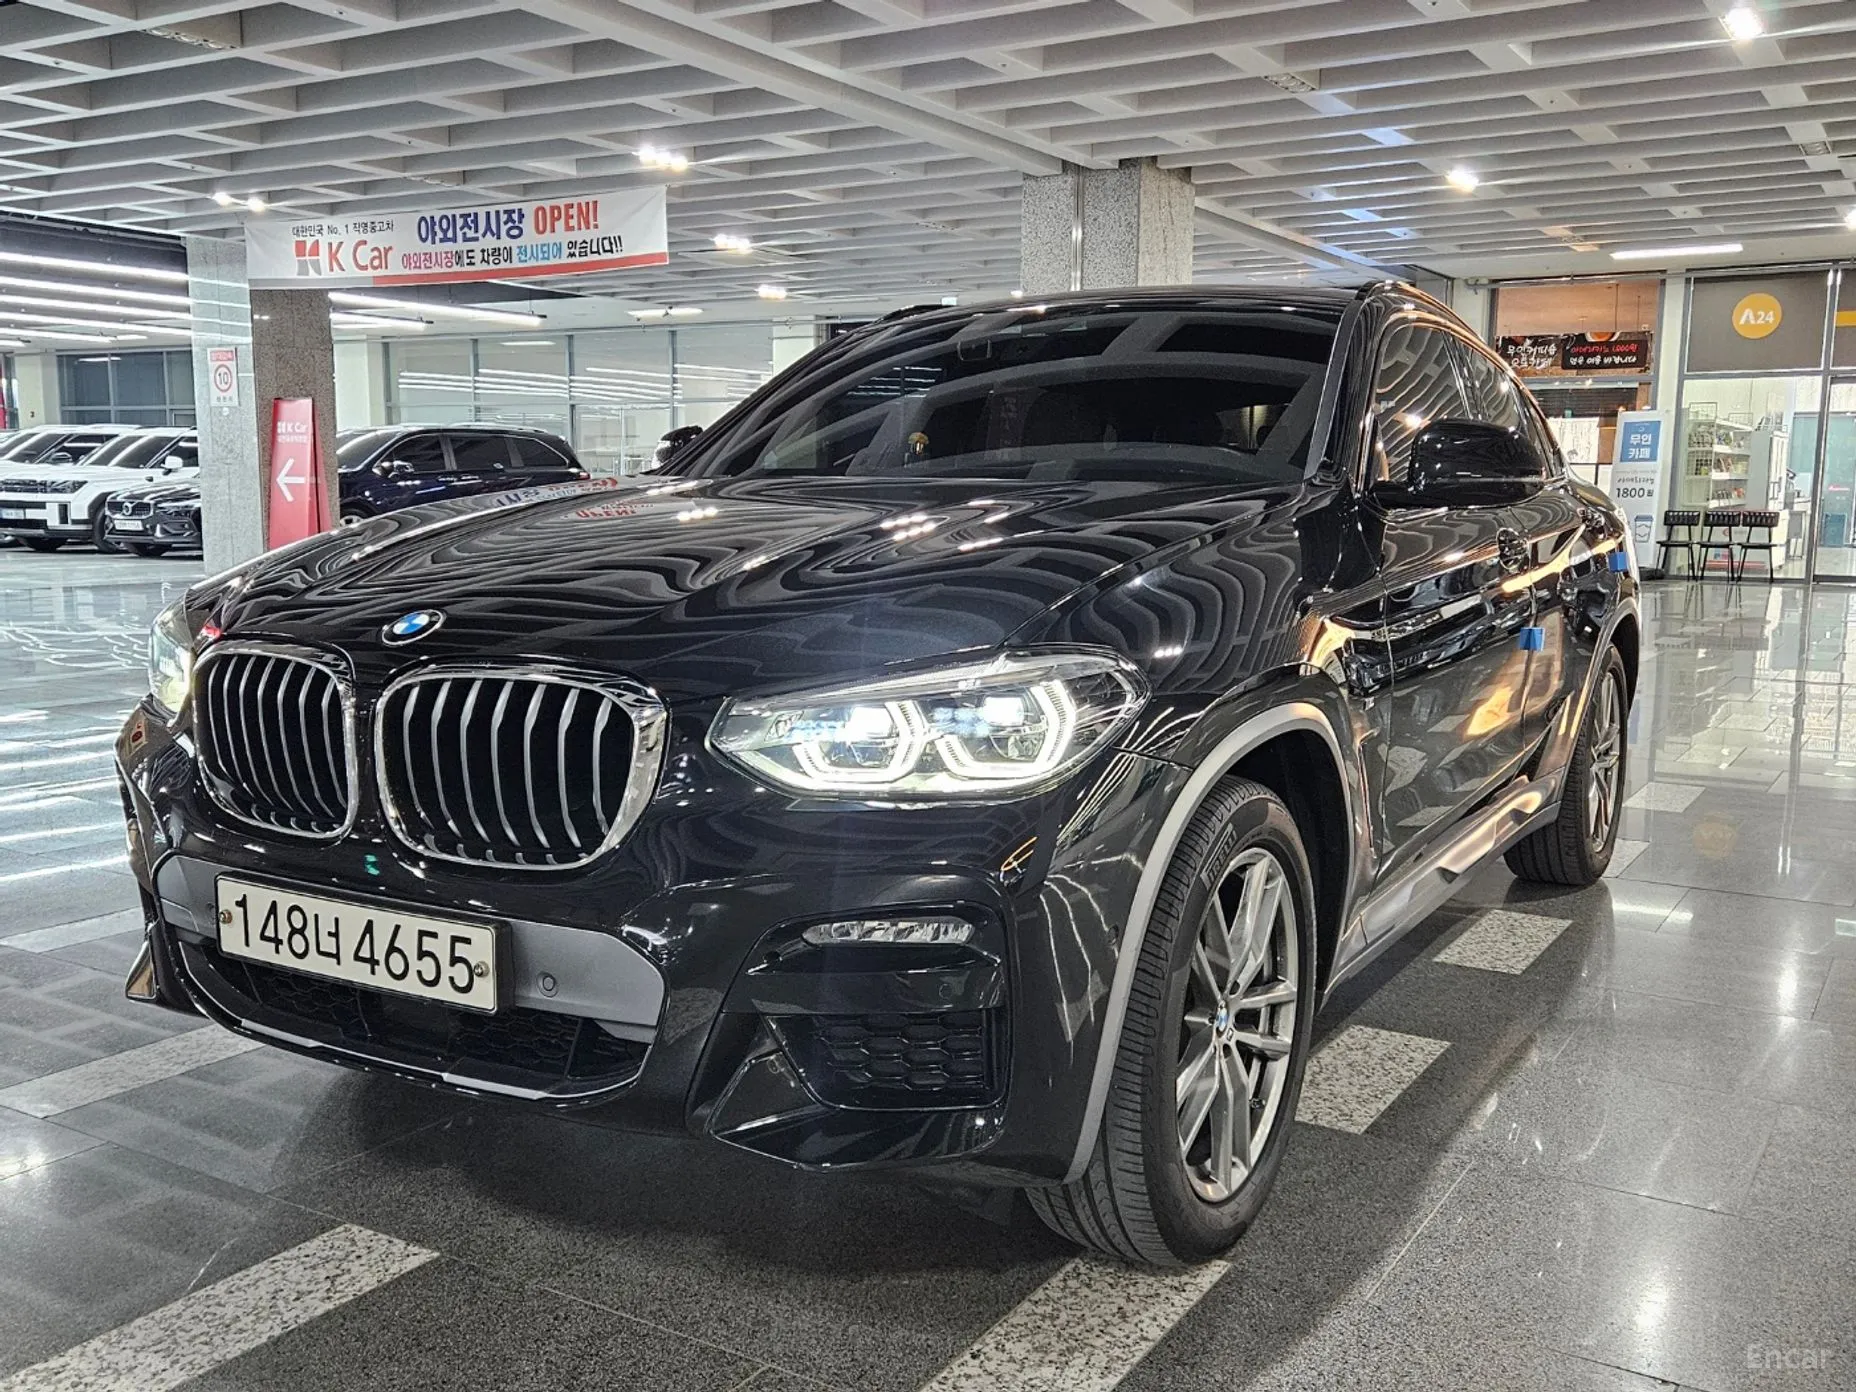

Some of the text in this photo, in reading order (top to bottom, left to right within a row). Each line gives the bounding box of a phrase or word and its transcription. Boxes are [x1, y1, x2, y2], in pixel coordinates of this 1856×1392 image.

[291, 224, 324, 238] 대한민국
[327, 224, 341, 236] No.
[417, 199, 599, 245] 야외전시장 OPEN!
[327, 239, 394, 272] K Car
[401, 235, 624, 271] 야외전시장에도 차량이 전시되어 있습니다!!
[1738, 307, 1775, 326] A24
[217, 371, 229, 386] 10
[1630, 433, 1652, 446] 무인
[1628, 447, 1650, 459] 카페
[234, 893, 476, 995] 148너 4655
